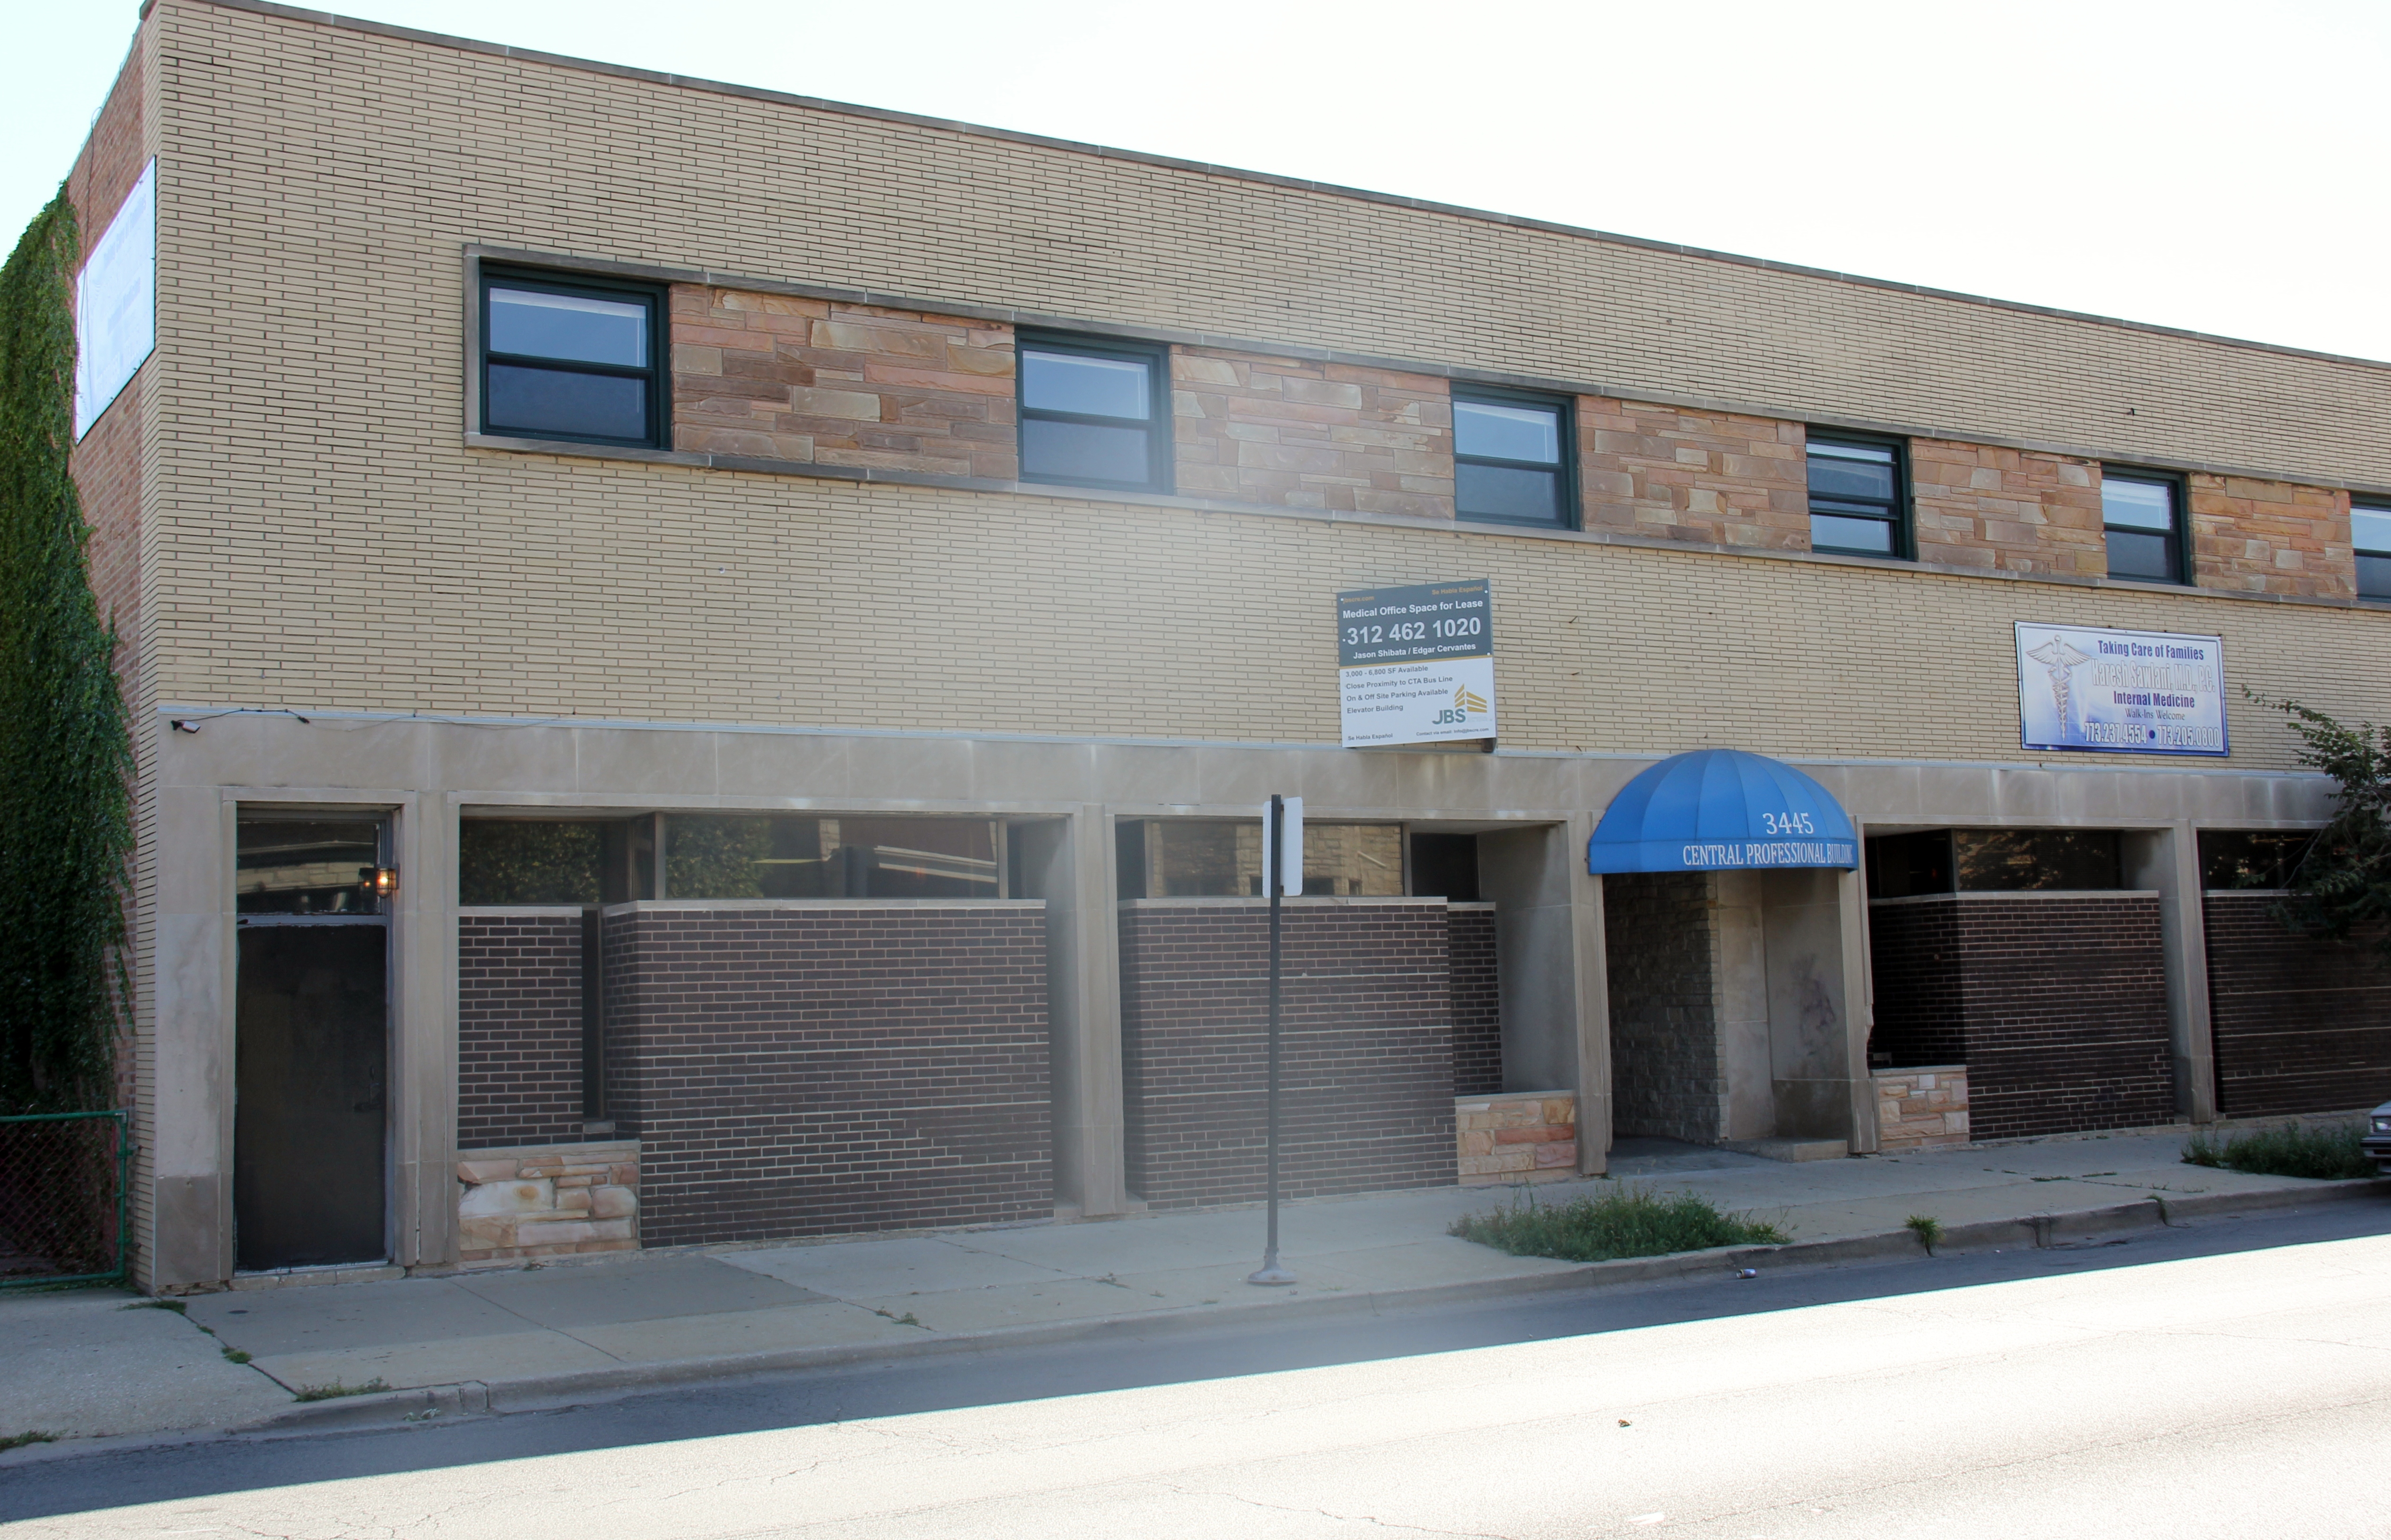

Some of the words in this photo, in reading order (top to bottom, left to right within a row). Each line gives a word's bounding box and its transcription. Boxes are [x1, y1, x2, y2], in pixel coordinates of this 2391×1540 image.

[1343, 608, 1377, 618] Medical
[1380, 606, 1407, 616] Office
[1409, 604, 1437, 614] Space
[1440, 602, 1453, 610] for
[1455, 600, 1483, 609] Lease
[1347, 625, 1383, 645] 312
[1389, 622, 1425, 641] 462
[1432, 617, 1480, 638] 1020
[1353, 650, 1376, 659] Jason
[1378, 647, 1406, 657] Shibata
[1413, 645, 1435, 655] Edgar
[1437, 643, 1476, 652] Cervantes
[2098, 640, 2129, 657] Taking
[2131, 643, 2152, 657] Care
[2155, 644, 2164, 657] of
[2166, 645, 2204, 660] Families
[1367, 680, 1397, 689] Proximity
[2091, 659, 2128, 687] Haresh
[2130, 661, 2173, 692] Sawlani,
[2174, 663, 2198, 693] M.D.,
[2198, 665, 2215, 693] P.C.
[1391, 691, 1416, 699] Parking
[1418, 688, 1448, 696] Available
[2114, 691, 2150, 706] Internal
[2153, 693, 2195, 708] Medicine
[1376, 704, 1403, 712] Building
[2125, 708, 2154, 719] Walk-Ins
[2156, 710, 2185, 721] Welcome
[1432, 709, 1466, 725] JBS
[2084, 722, 2147, 744] 773.237.4554
[2157, 725, 2219, 747] 773.205.0800
[1763, 812, 1814, 835] 3445
[1683, 845, 1743, 865] CENTRAL
[1746, 843, 1825, 864] PROFESSIONAL
